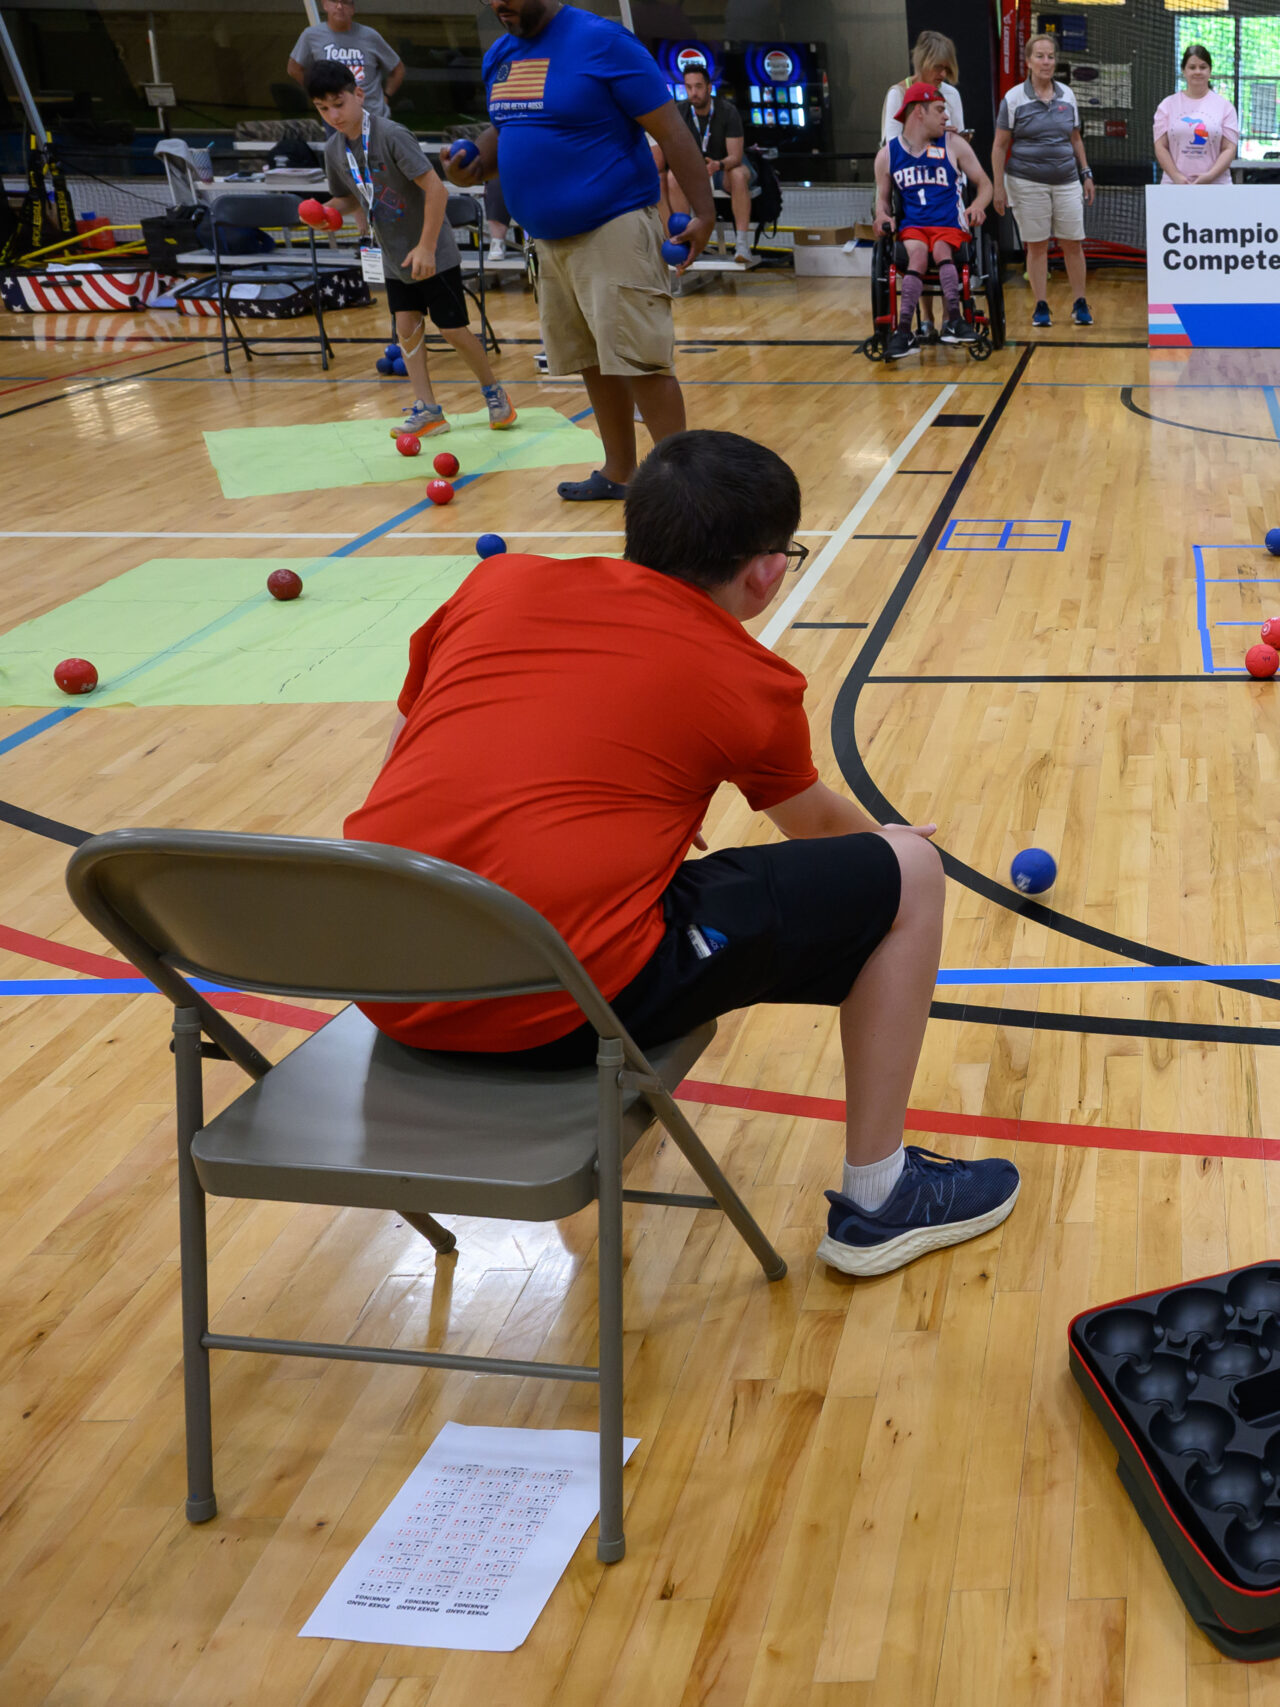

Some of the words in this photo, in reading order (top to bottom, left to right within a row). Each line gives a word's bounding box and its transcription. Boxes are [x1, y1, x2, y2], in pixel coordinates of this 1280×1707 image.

[323, 43, 365, 61] Team
[893, 165, 949, 190] PHILA
[917, 188, 927, 206] 1
[355, 1594, 390, 1602] RANKINGS
